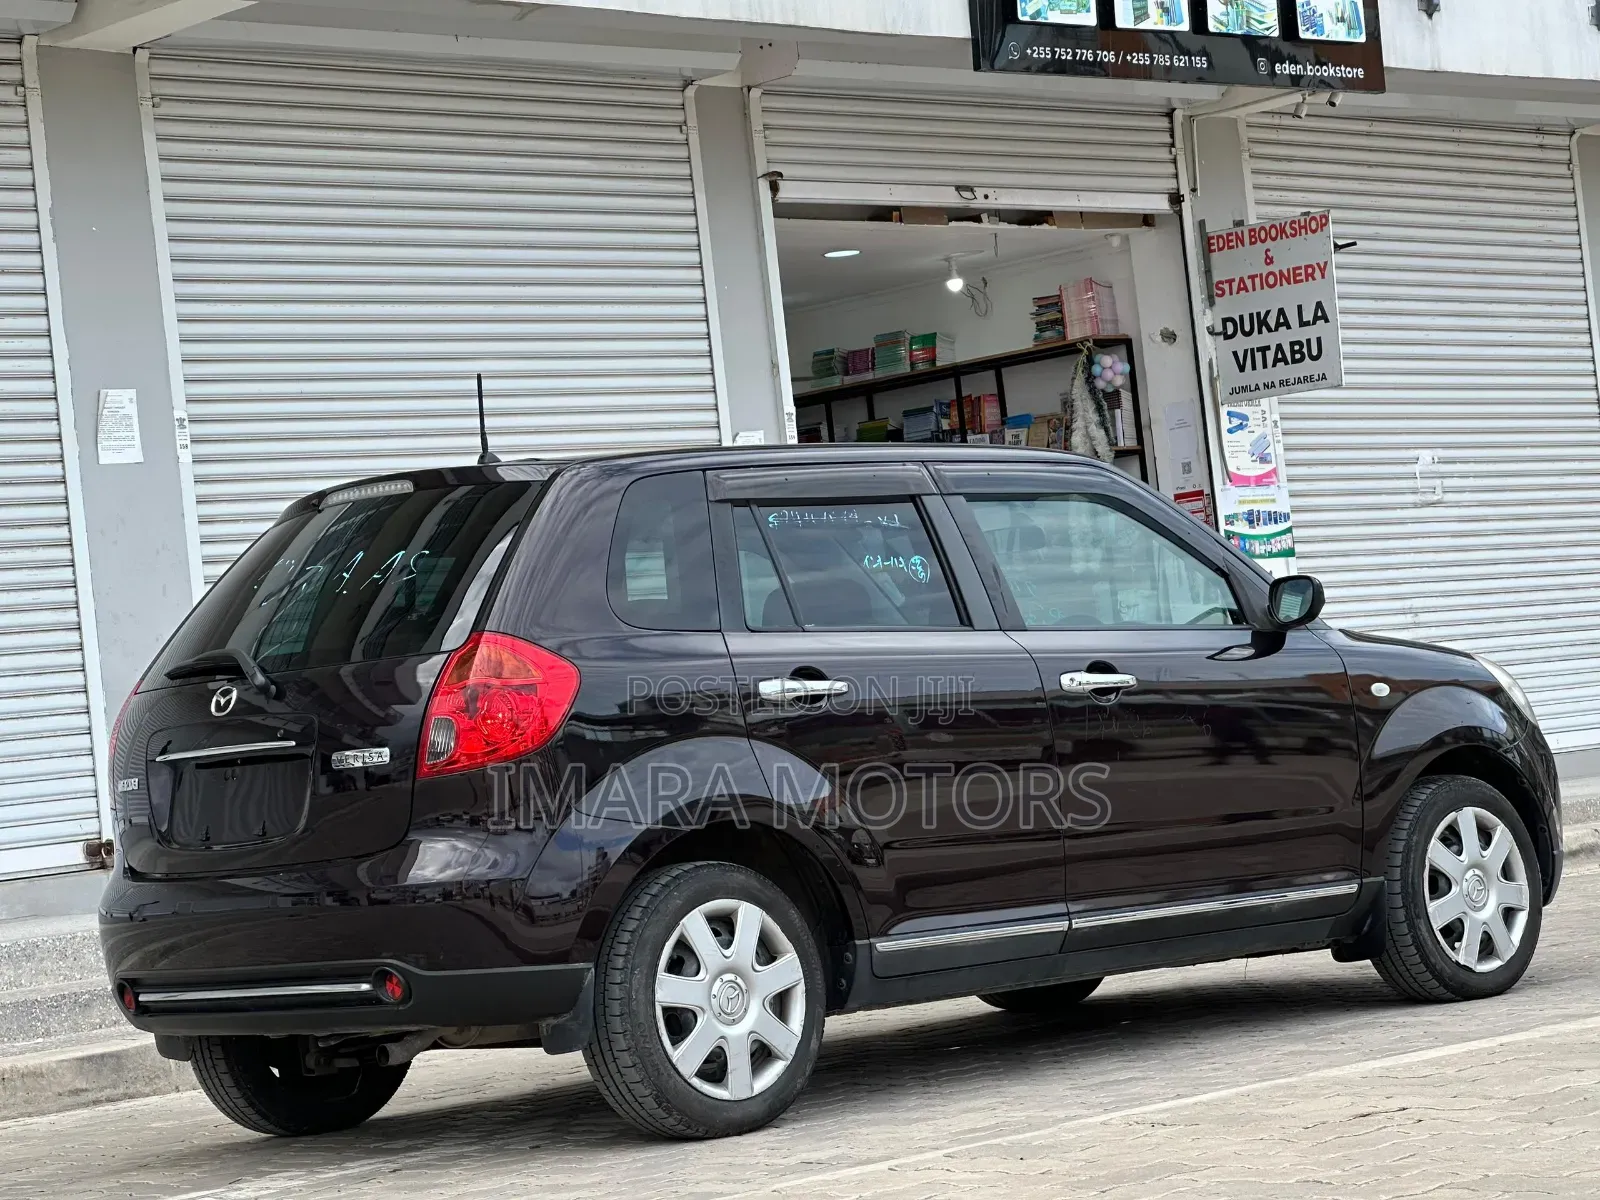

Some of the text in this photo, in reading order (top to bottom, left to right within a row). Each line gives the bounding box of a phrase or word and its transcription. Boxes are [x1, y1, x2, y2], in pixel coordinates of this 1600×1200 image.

[1026, 46, 1207, 68] +255 752 776 706 / +255 785 621 155
[1274, 60, 1364, 79] eden.bookstore
[1207, 213, 1329, 254] EDEN BOOKSHOP
[1264, 248, 1274, 266] &
[1214, 261, 1329, 298] STATIONERY
[1221, 300, 1330, 341] DUKA LA
[1232, 336, 1323, 373] VITABU
[1229, 372, 1328, 396] JUMLA NA REJAREJA
